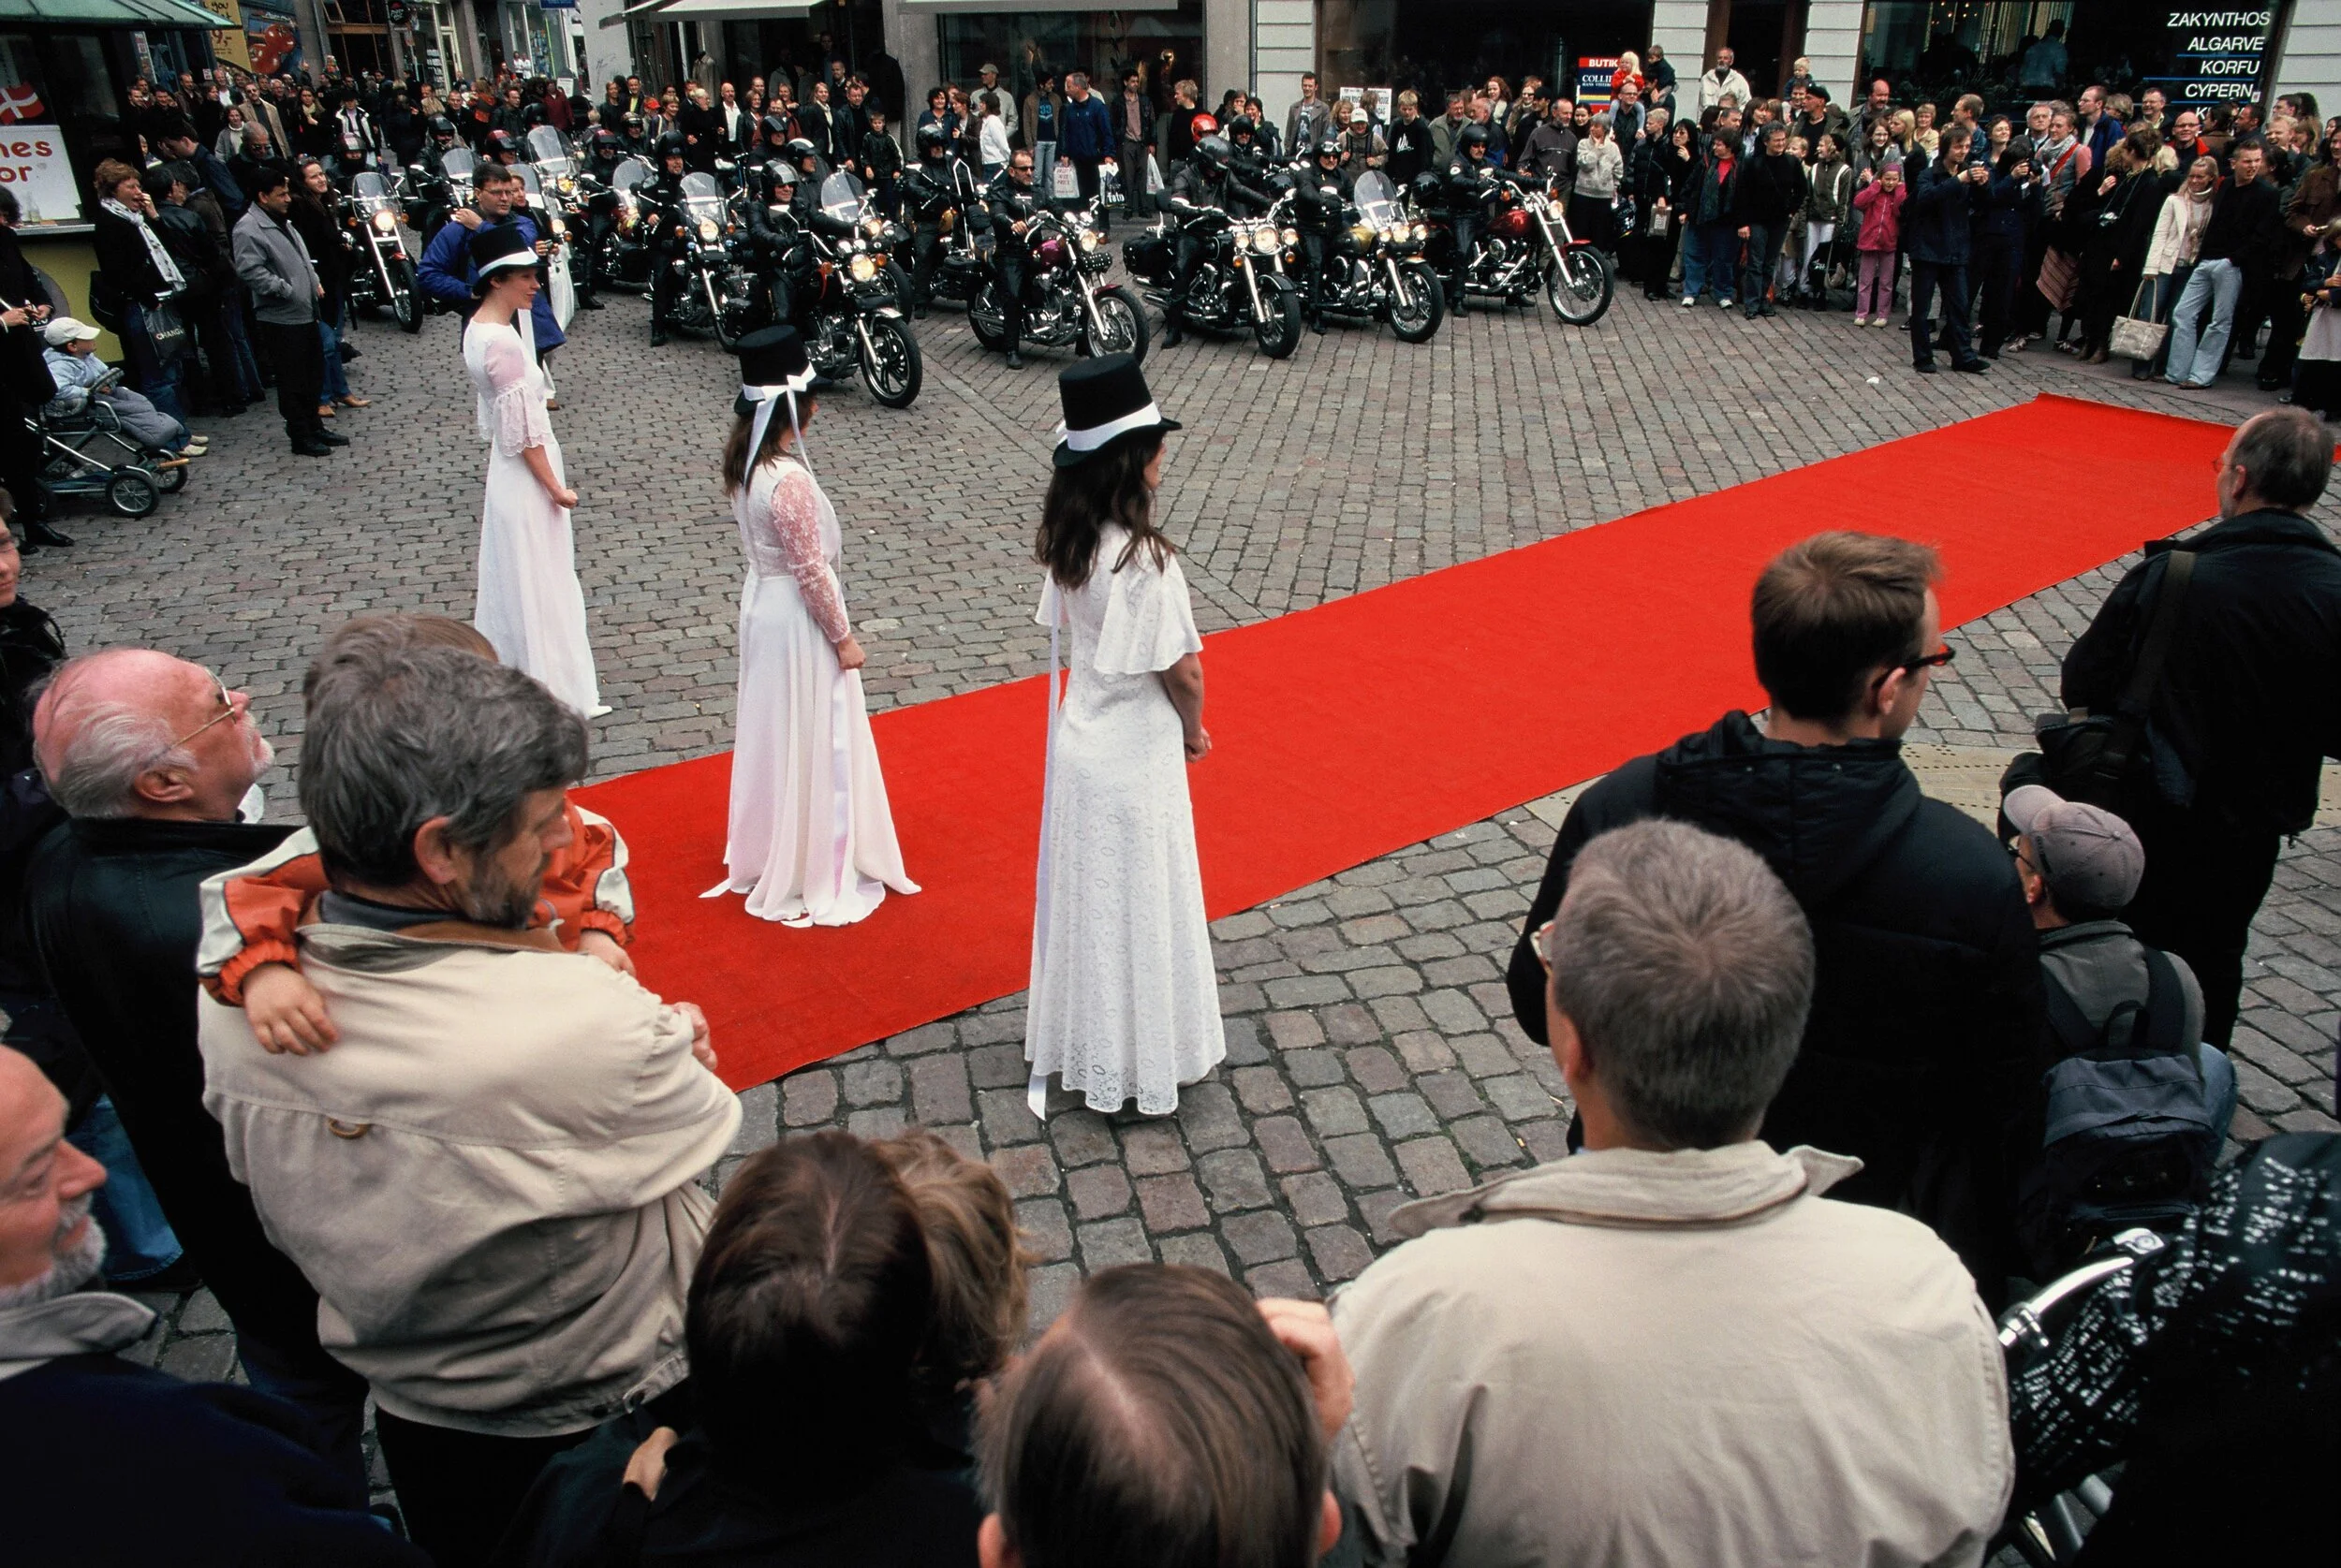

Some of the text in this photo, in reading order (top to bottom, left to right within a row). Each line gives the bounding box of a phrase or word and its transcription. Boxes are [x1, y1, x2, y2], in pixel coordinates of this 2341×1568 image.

[2167, 11, 2271, 27] ZAKYNTHOS
[2187, 37, 2265, 51] ALGARVE
[1588, 58, 1618, 68] BUTIK
[2201, 60, 2260, 75] KORFU
[2185, 83, 2254, 98] CYPERN
